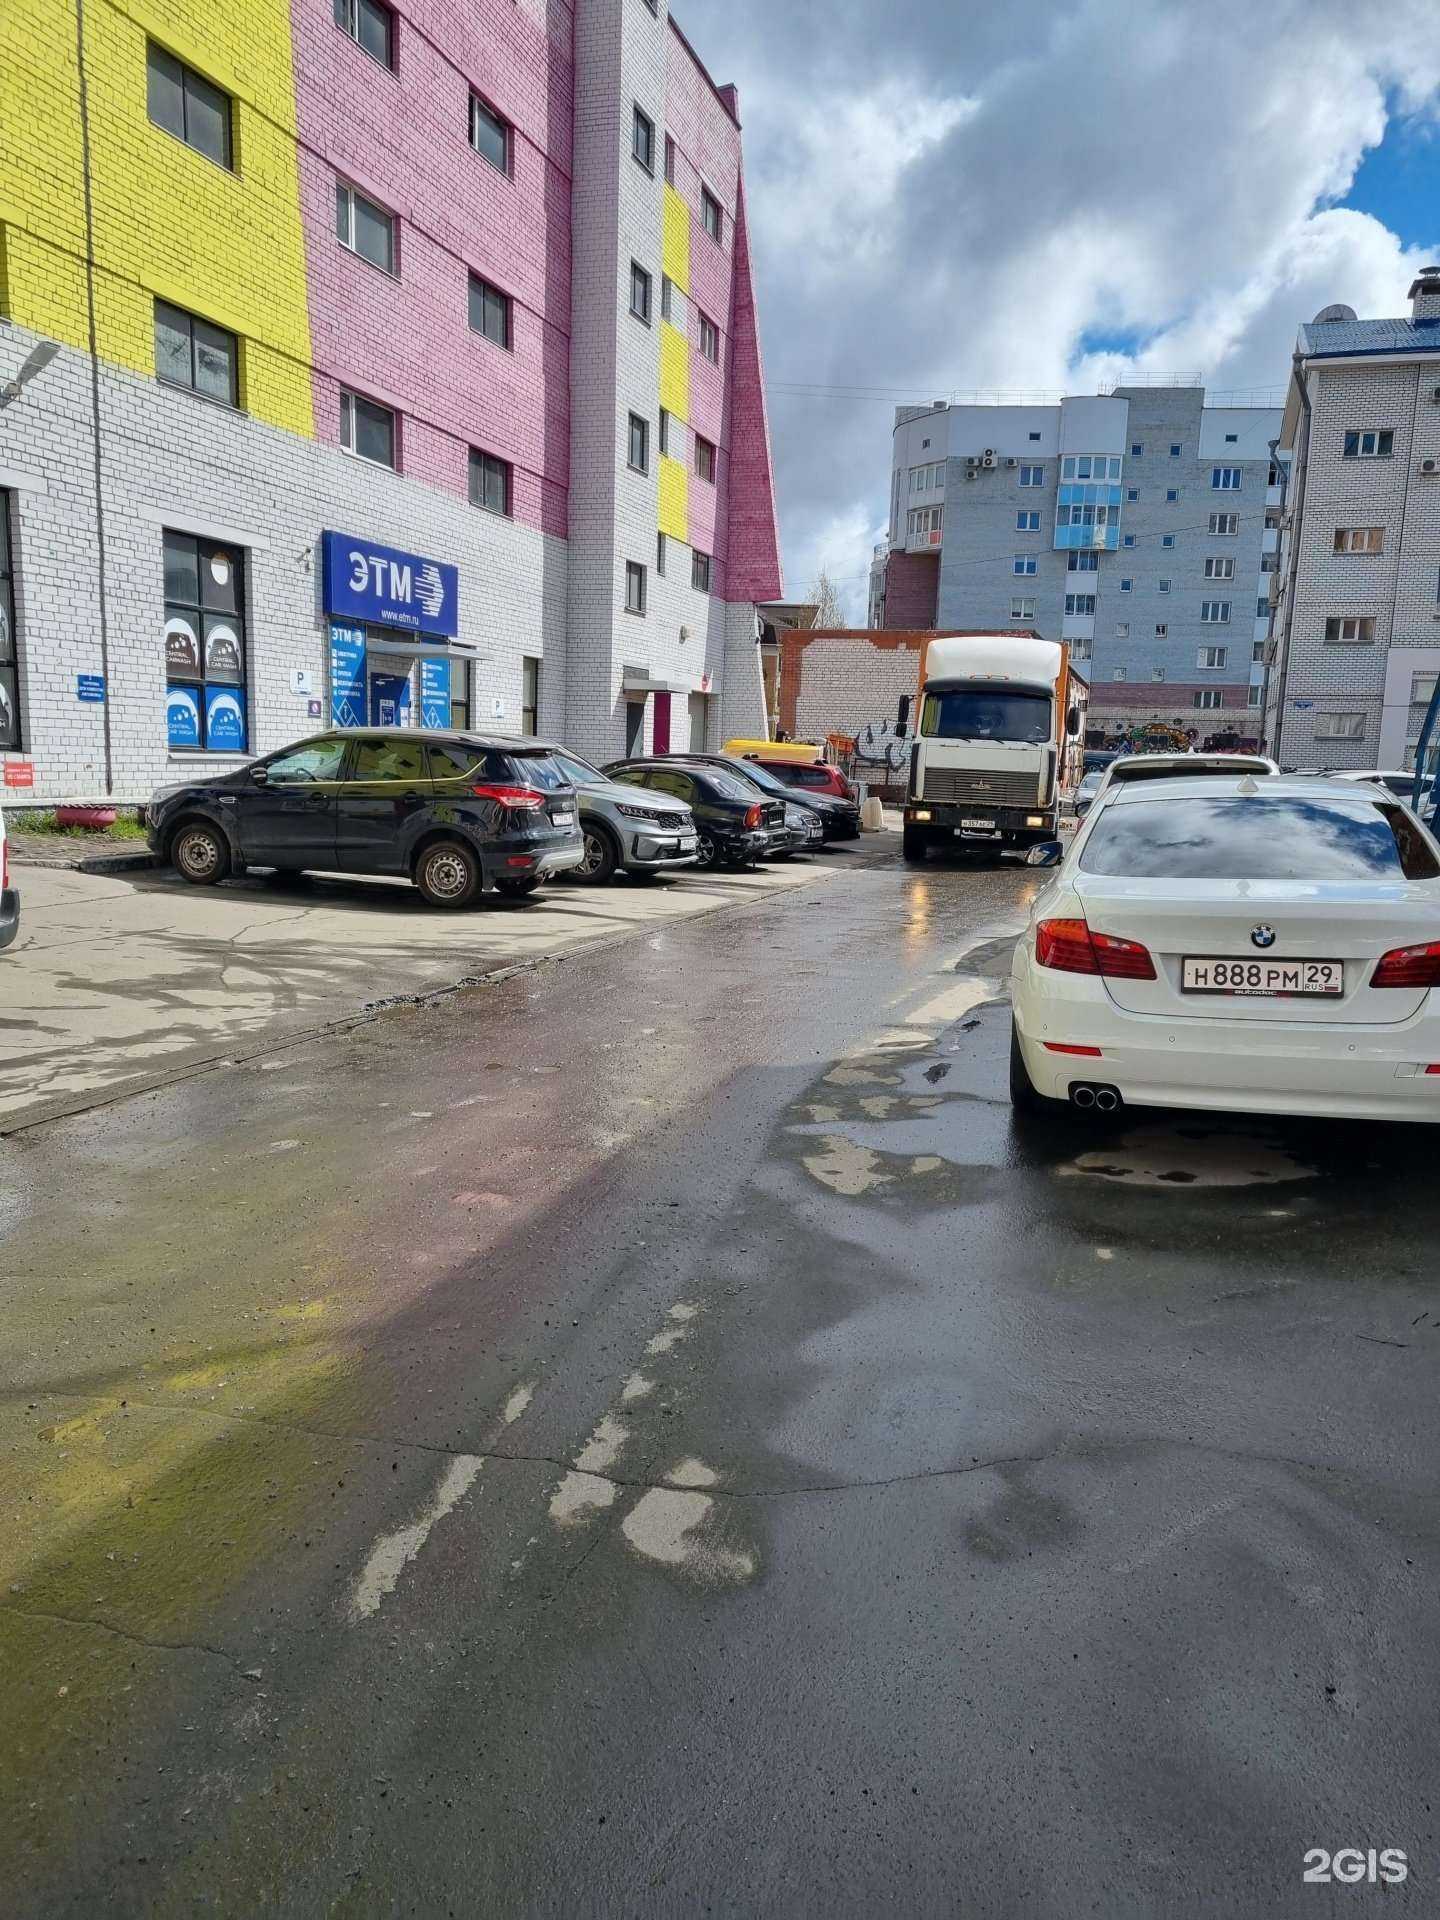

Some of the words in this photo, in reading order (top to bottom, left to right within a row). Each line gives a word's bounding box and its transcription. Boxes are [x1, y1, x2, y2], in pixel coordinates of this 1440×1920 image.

[349, 551, 411, 604] ЭТМ
[381, 609, 419, 625] www.etm.ru
[332, 627, 351, 643] ЭТМ
[297, 672, 304, 684] P
[1307, 965, 1333, 983] 29
